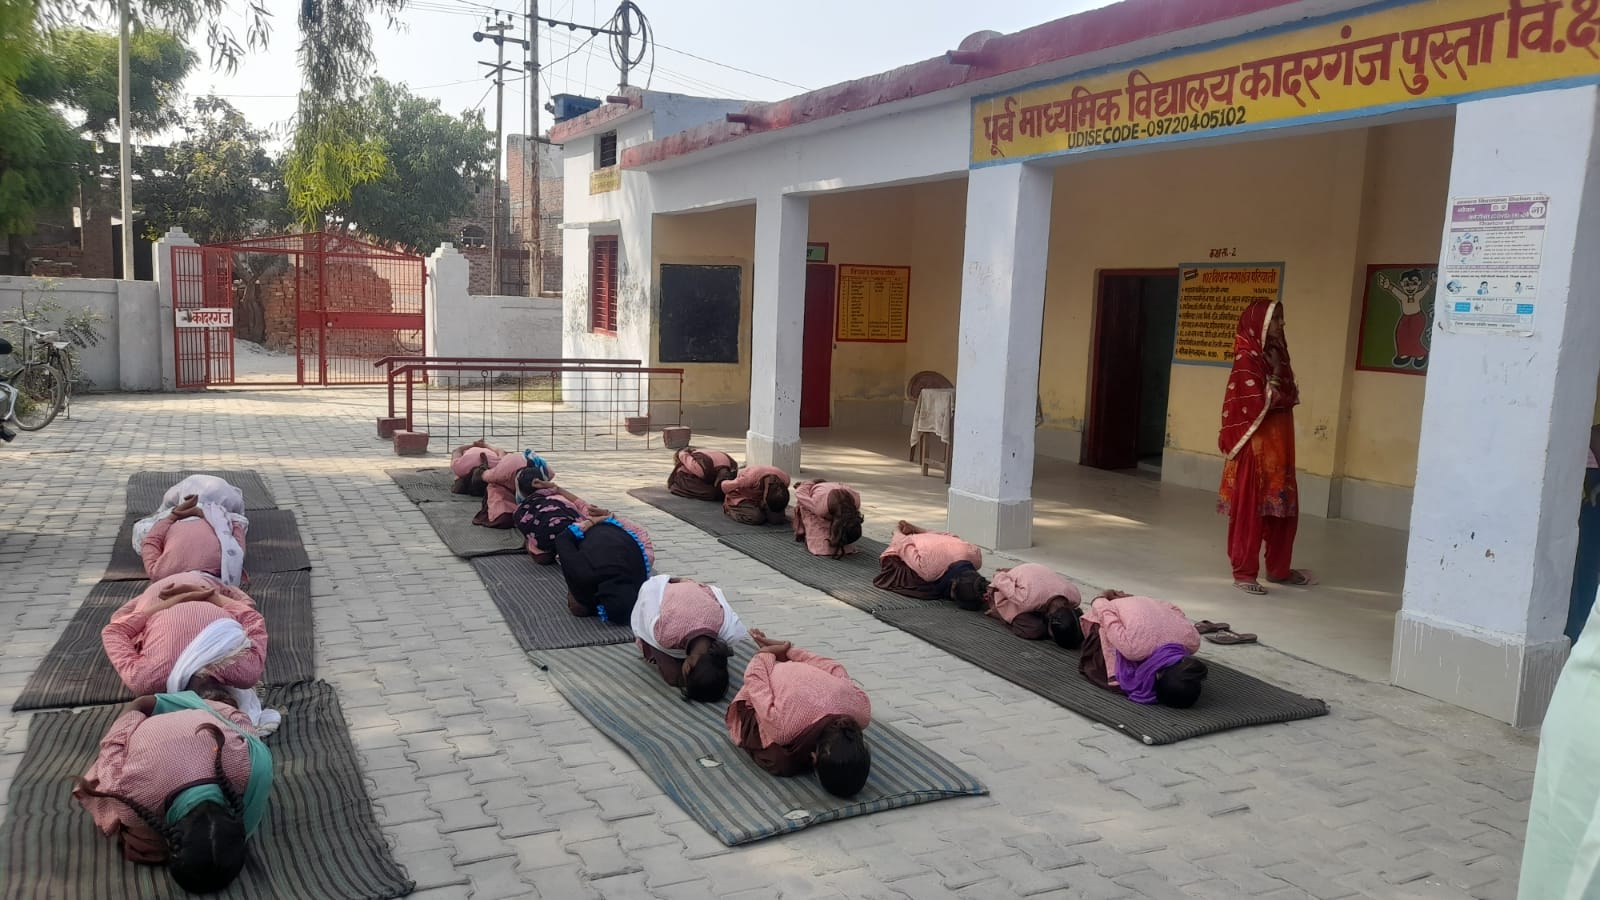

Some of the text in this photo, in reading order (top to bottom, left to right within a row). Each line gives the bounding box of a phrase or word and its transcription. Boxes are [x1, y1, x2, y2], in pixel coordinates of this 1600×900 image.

[983, 96, 1018, 157] पूर्व
[1019, 86, 1124, 138] माध्यमिक
[1125, 69, 1240, 121] विद्यालय
[1240, 25, 1400, 107] कादरगंज
[192, 308, 231, 326] कादरगंज
